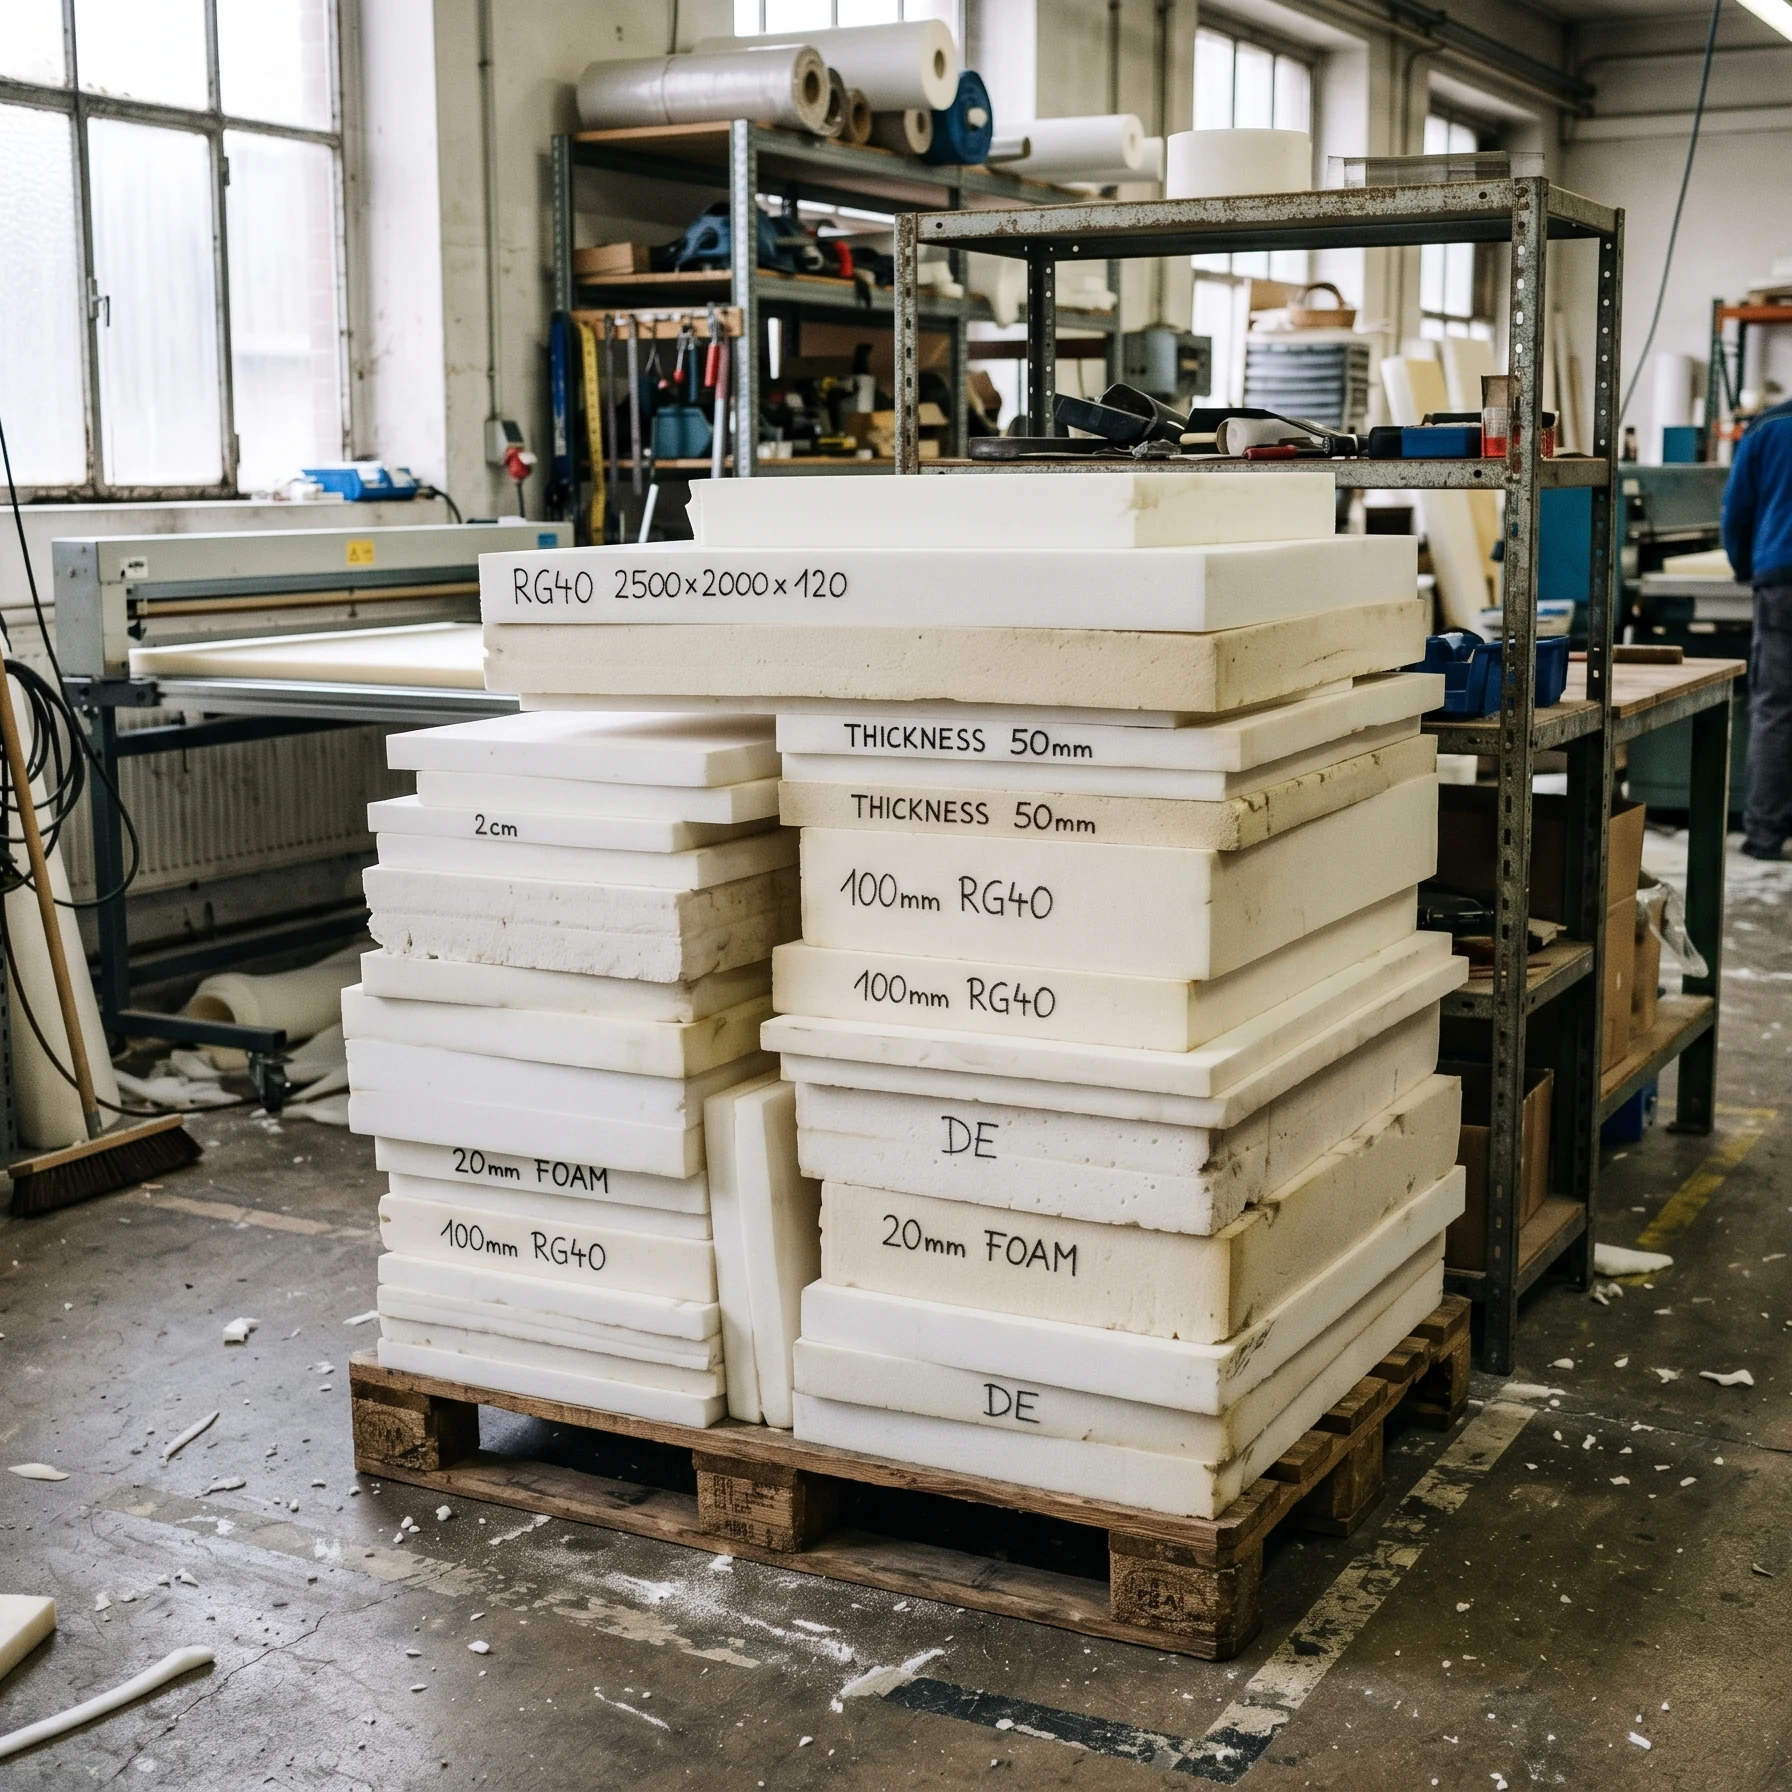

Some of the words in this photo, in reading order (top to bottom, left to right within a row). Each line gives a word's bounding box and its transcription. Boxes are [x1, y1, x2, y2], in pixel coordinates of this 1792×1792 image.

[513, 567, 594, 605] RG40
[843, 723, 986, 753] THICKNESS
[1010, 728, 1093, 759] 50mm
[474, 813, 518, 838] 2cm
[850, 793, 990, 826] THICKNESS
[1013, 801, 1096, 835] 50mm
[839, 868, 941, 912] 100mm
[958, 875, 1054, 920] RG40
[853, 969, 950, 1009] 100mm
[966, 976, 1056, 1019] RG40
[940, 1115, 1000, 1160] DE
[452, 1147, 521, 1181] 20mm
[533, 1157, 610, 1194] FOAM
[440, 1218, 518, 1258] 100mm
[530, 1230, 607, 1272] RG40
[882, 1214, 967, 1259] 20mm
[983, 1229, 1078, 1277] FOAM
[983, 1383, 1041, 1425] DE
